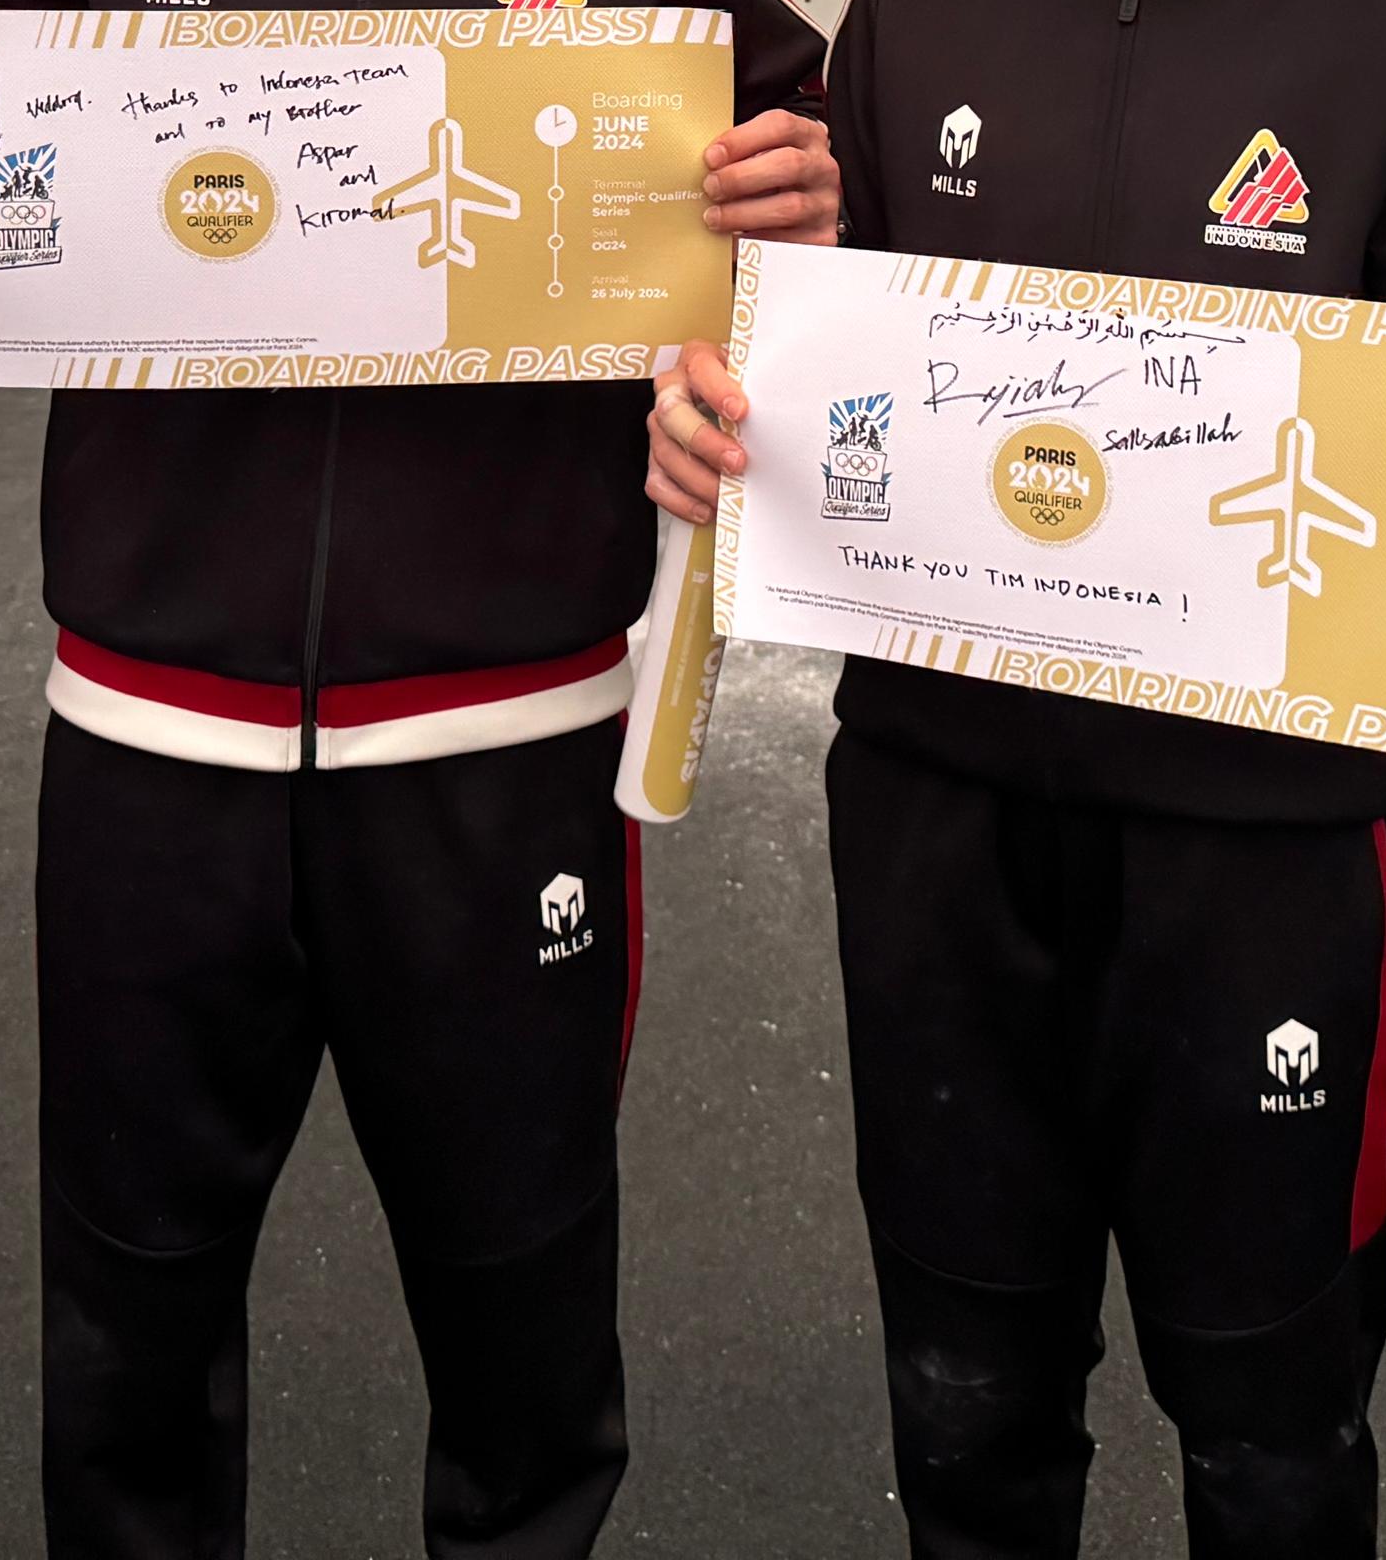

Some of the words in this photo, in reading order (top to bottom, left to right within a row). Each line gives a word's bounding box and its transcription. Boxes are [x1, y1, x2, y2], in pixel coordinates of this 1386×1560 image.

[166, 10, 490, 48] BOARDING
[499, 8, 652, 48] PASS
[592, 92, 683, 111] Boarding
[592, 115, 650, 133] JUNE
[593, 134, 645, 151] 2024
[194, 174, 245, 189] PARIS
[931, 174, 978, 198] MILLS
[180, 189, 259, 214] 2024
[592, 193, 646, 205] Olympic
[648, 190, 704, 204] Qualifier
[187, 215, 253, 227] QUALIFIER
[592, 206, 630, 217] Series
[591, 240, 627, 251] OG24
[1207, 232, 1302, 251] INDONESIA
[591, 288, 607, 299] 26
[609, 288, 635, 300] July
[638, 288, 669, 299] 2024
[1014, 265, 1355, 340] BOARDING
[175, 348, 491, 388] BOARDING
[500, 344, 651, 383] PASS
[1145, 355, 1201, 395] INA
[1025, 445, 1076, 467] PARIS
[828, 476, 883, 504] OLYMPIC
[1009, 460, 1090, 497] 2024
[1015, 490, 1082, 511] QUALIFIER
[838, 545, 915, 573] THANK
[924, 561, 968, 580] YOU
[985, 568, 1025, 588] TIM
[1035, 577, 1162, 607] INDONESIA
[996, 648, 1334, 740] BOARDING
[539, 929, 594, 967] MILLS
[1259, 1089, 1327, 1114] MILLS
